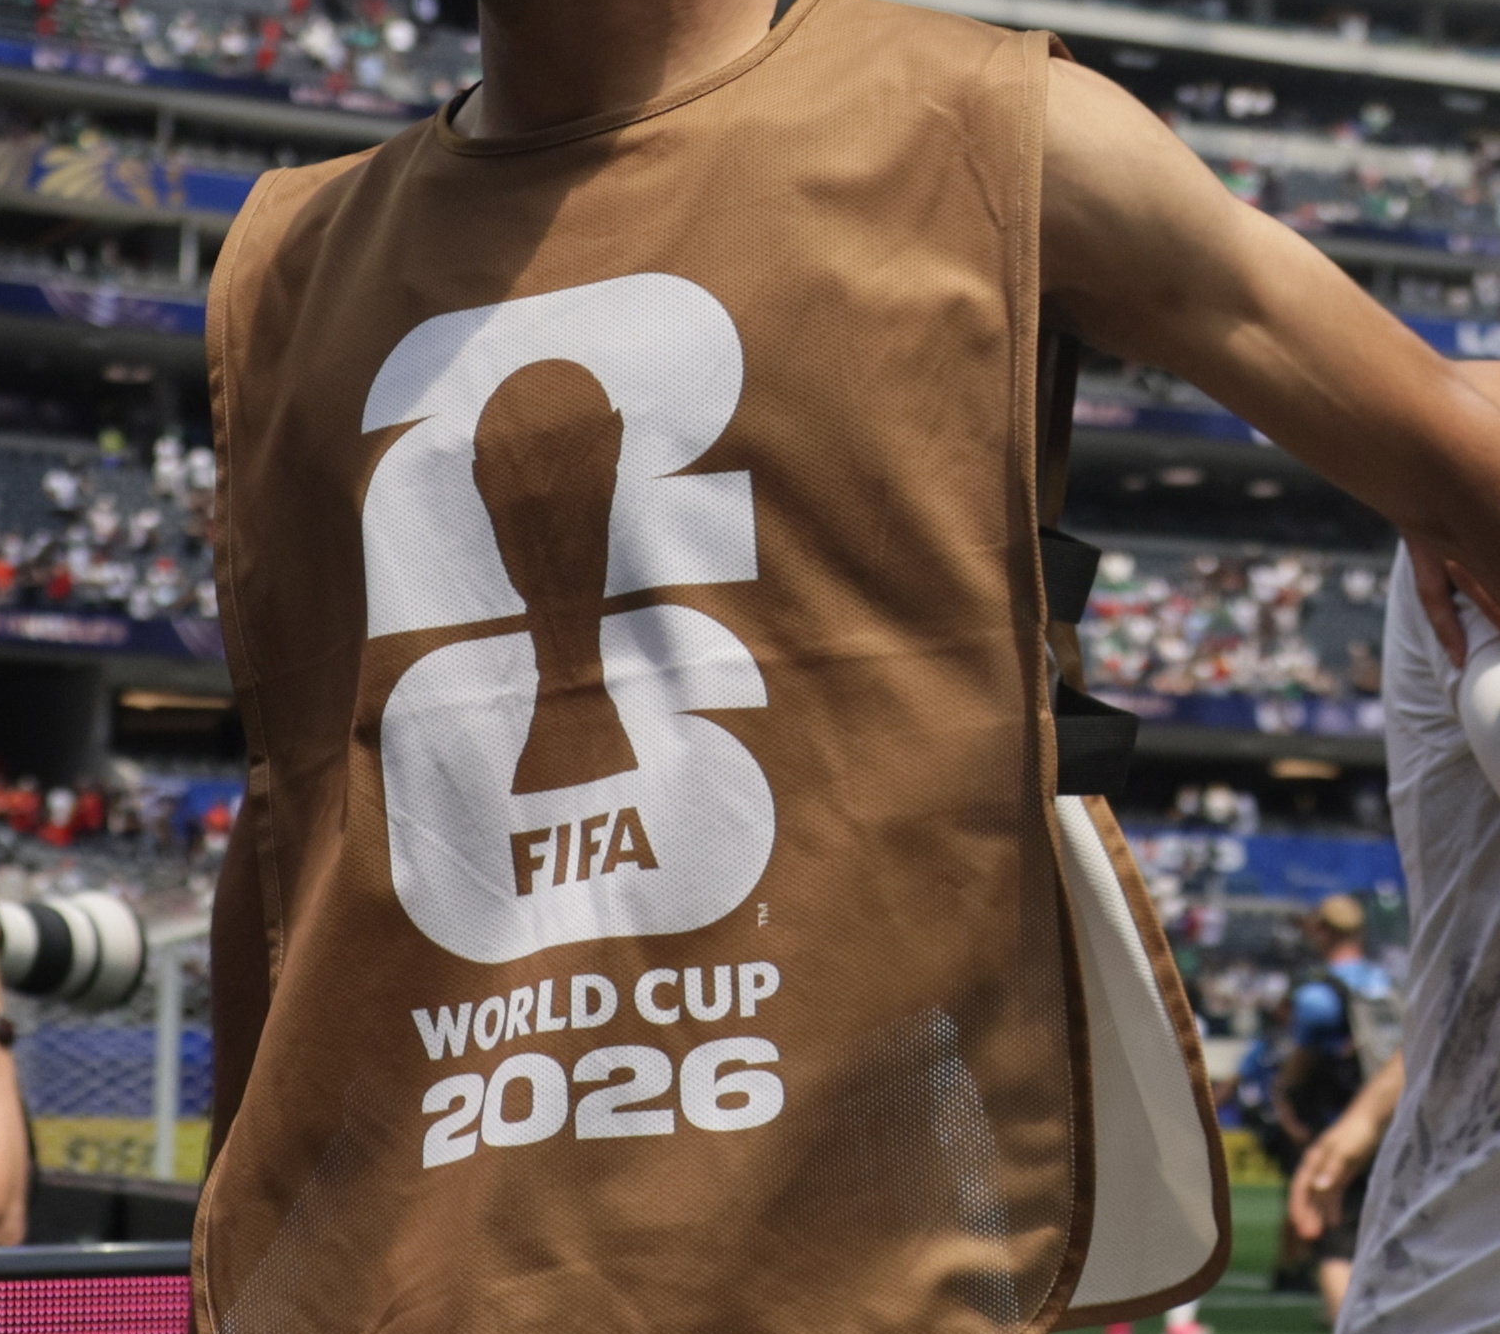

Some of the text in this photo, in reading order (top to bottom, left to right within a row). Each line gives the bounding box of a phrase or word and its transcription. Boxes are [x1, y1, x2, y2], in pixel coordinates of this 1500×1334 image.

[510, 806, 660, 897] FIFA
[411, 961, 781, 1061] WORLD CUP
[421, 1036, 785, 1169] 2026
